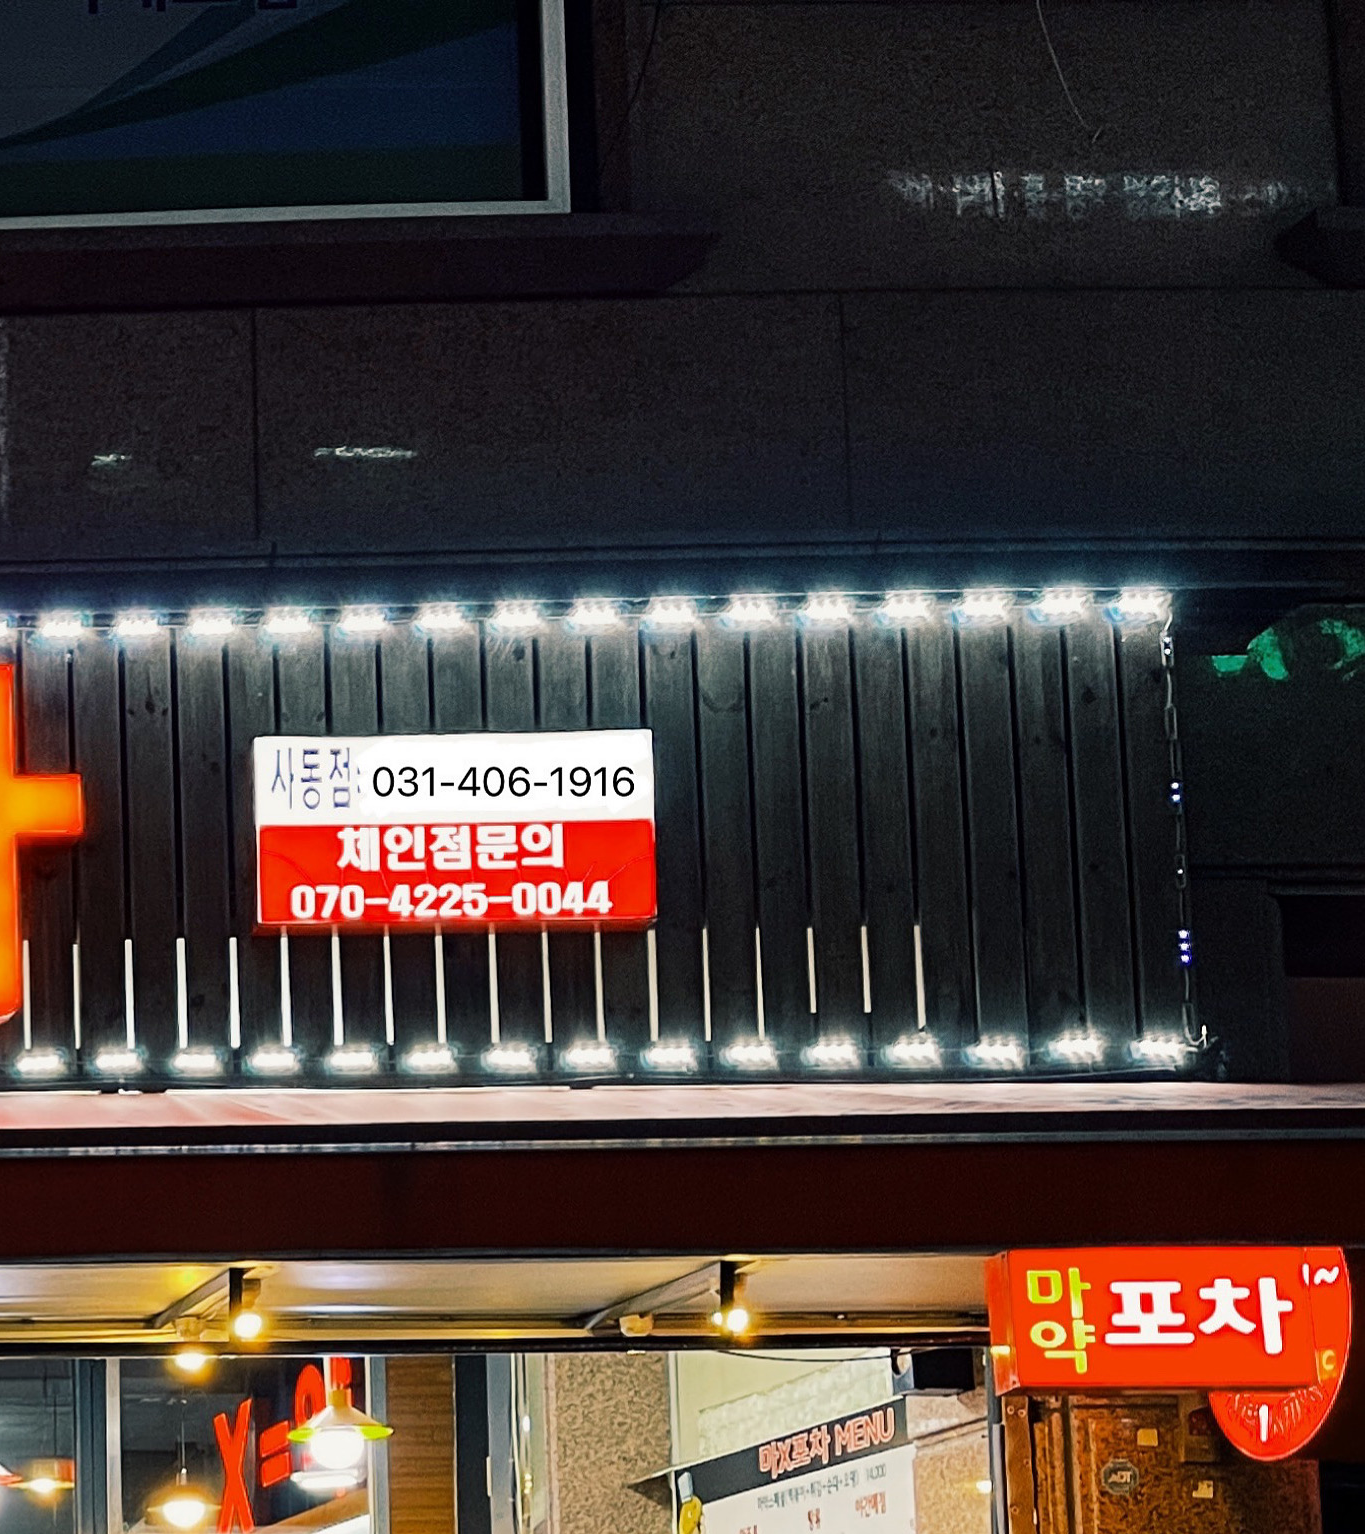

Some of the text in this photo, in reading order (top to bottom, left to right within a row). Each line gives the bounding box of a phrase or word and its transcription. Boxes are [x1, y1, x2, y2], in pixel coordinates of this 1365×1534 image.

[336, 822, 565, 872] 체인점문의
[290, 880, 613, 919] 070-4225-0044
[1104, 1277, 1294, 1355] 포차
[759, 1407, 895, 1479] 마X포차 MENU
